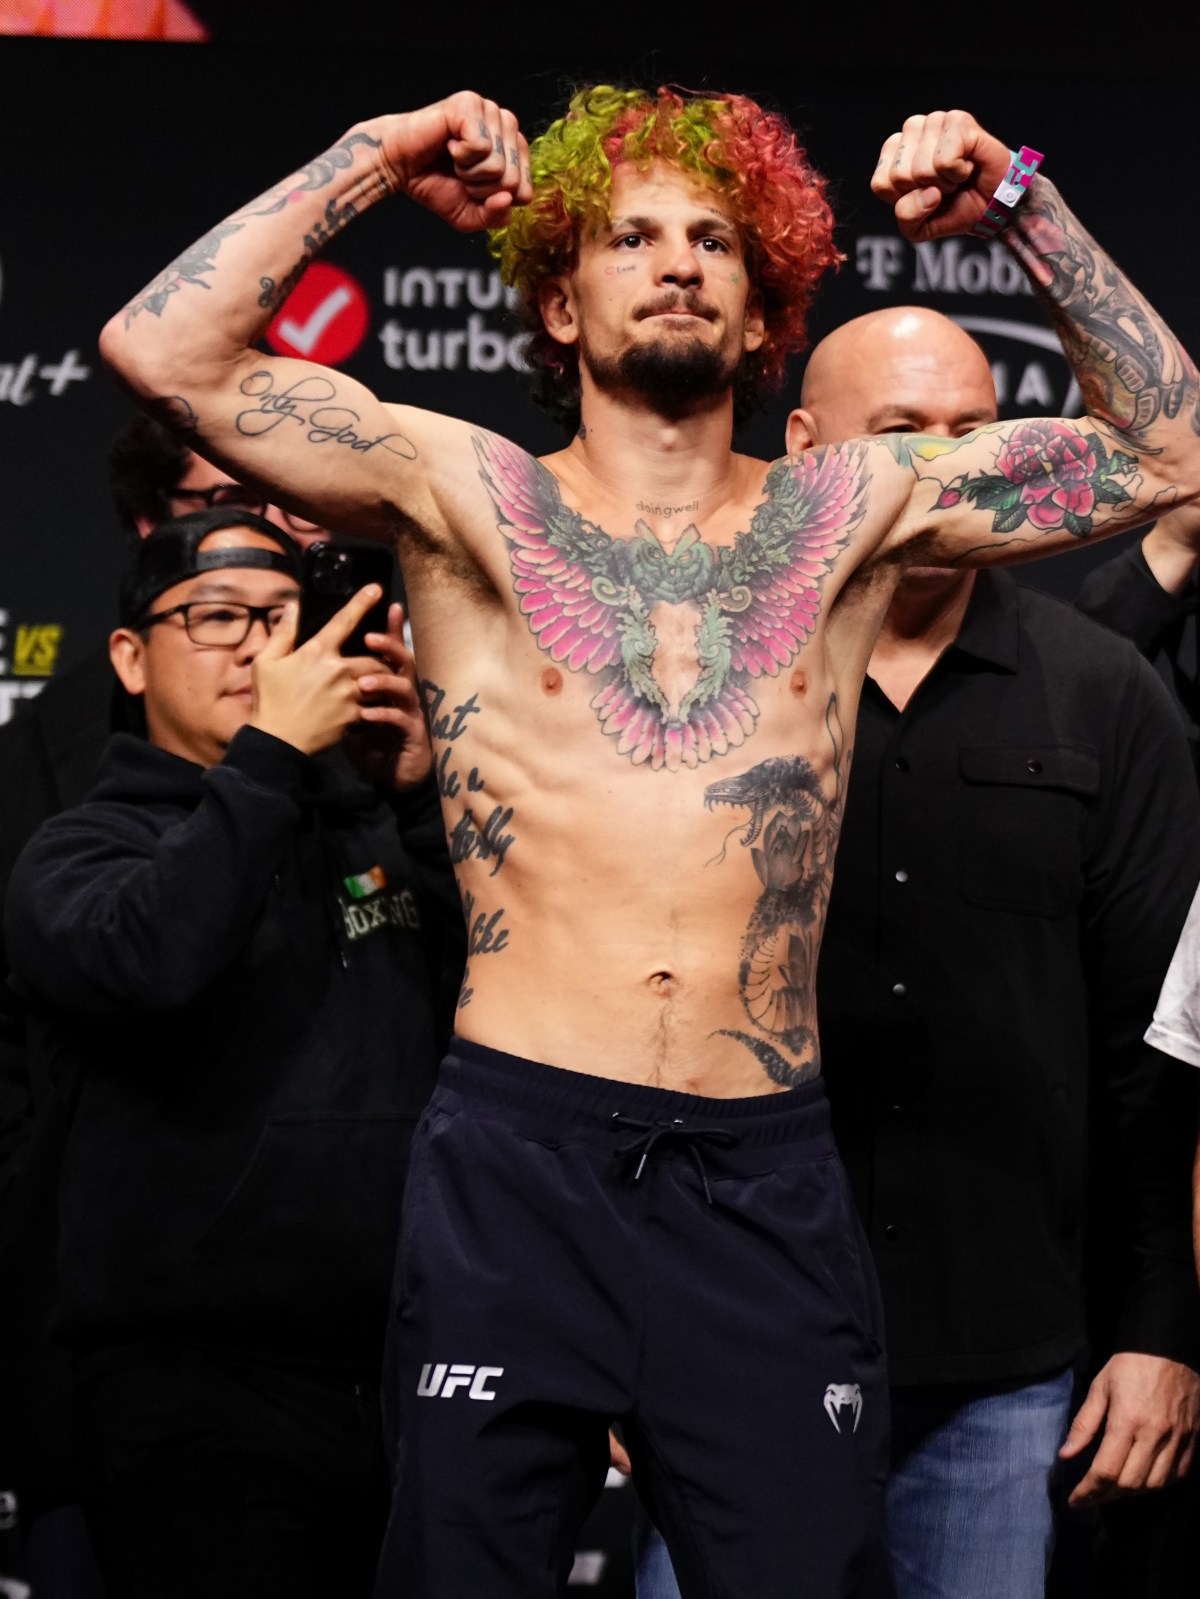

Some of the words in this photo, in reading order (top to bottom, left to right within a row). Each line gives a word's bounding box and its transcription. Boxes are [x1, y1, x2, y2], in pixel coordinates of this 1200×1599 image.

[913, 240, 1035, 294] Mob
[236, 370, 337, 437] Only
[307, 406, 418, 461] God
[14, 624, 62, 676] VS
[417, 1363, 504, 1401] UFC
